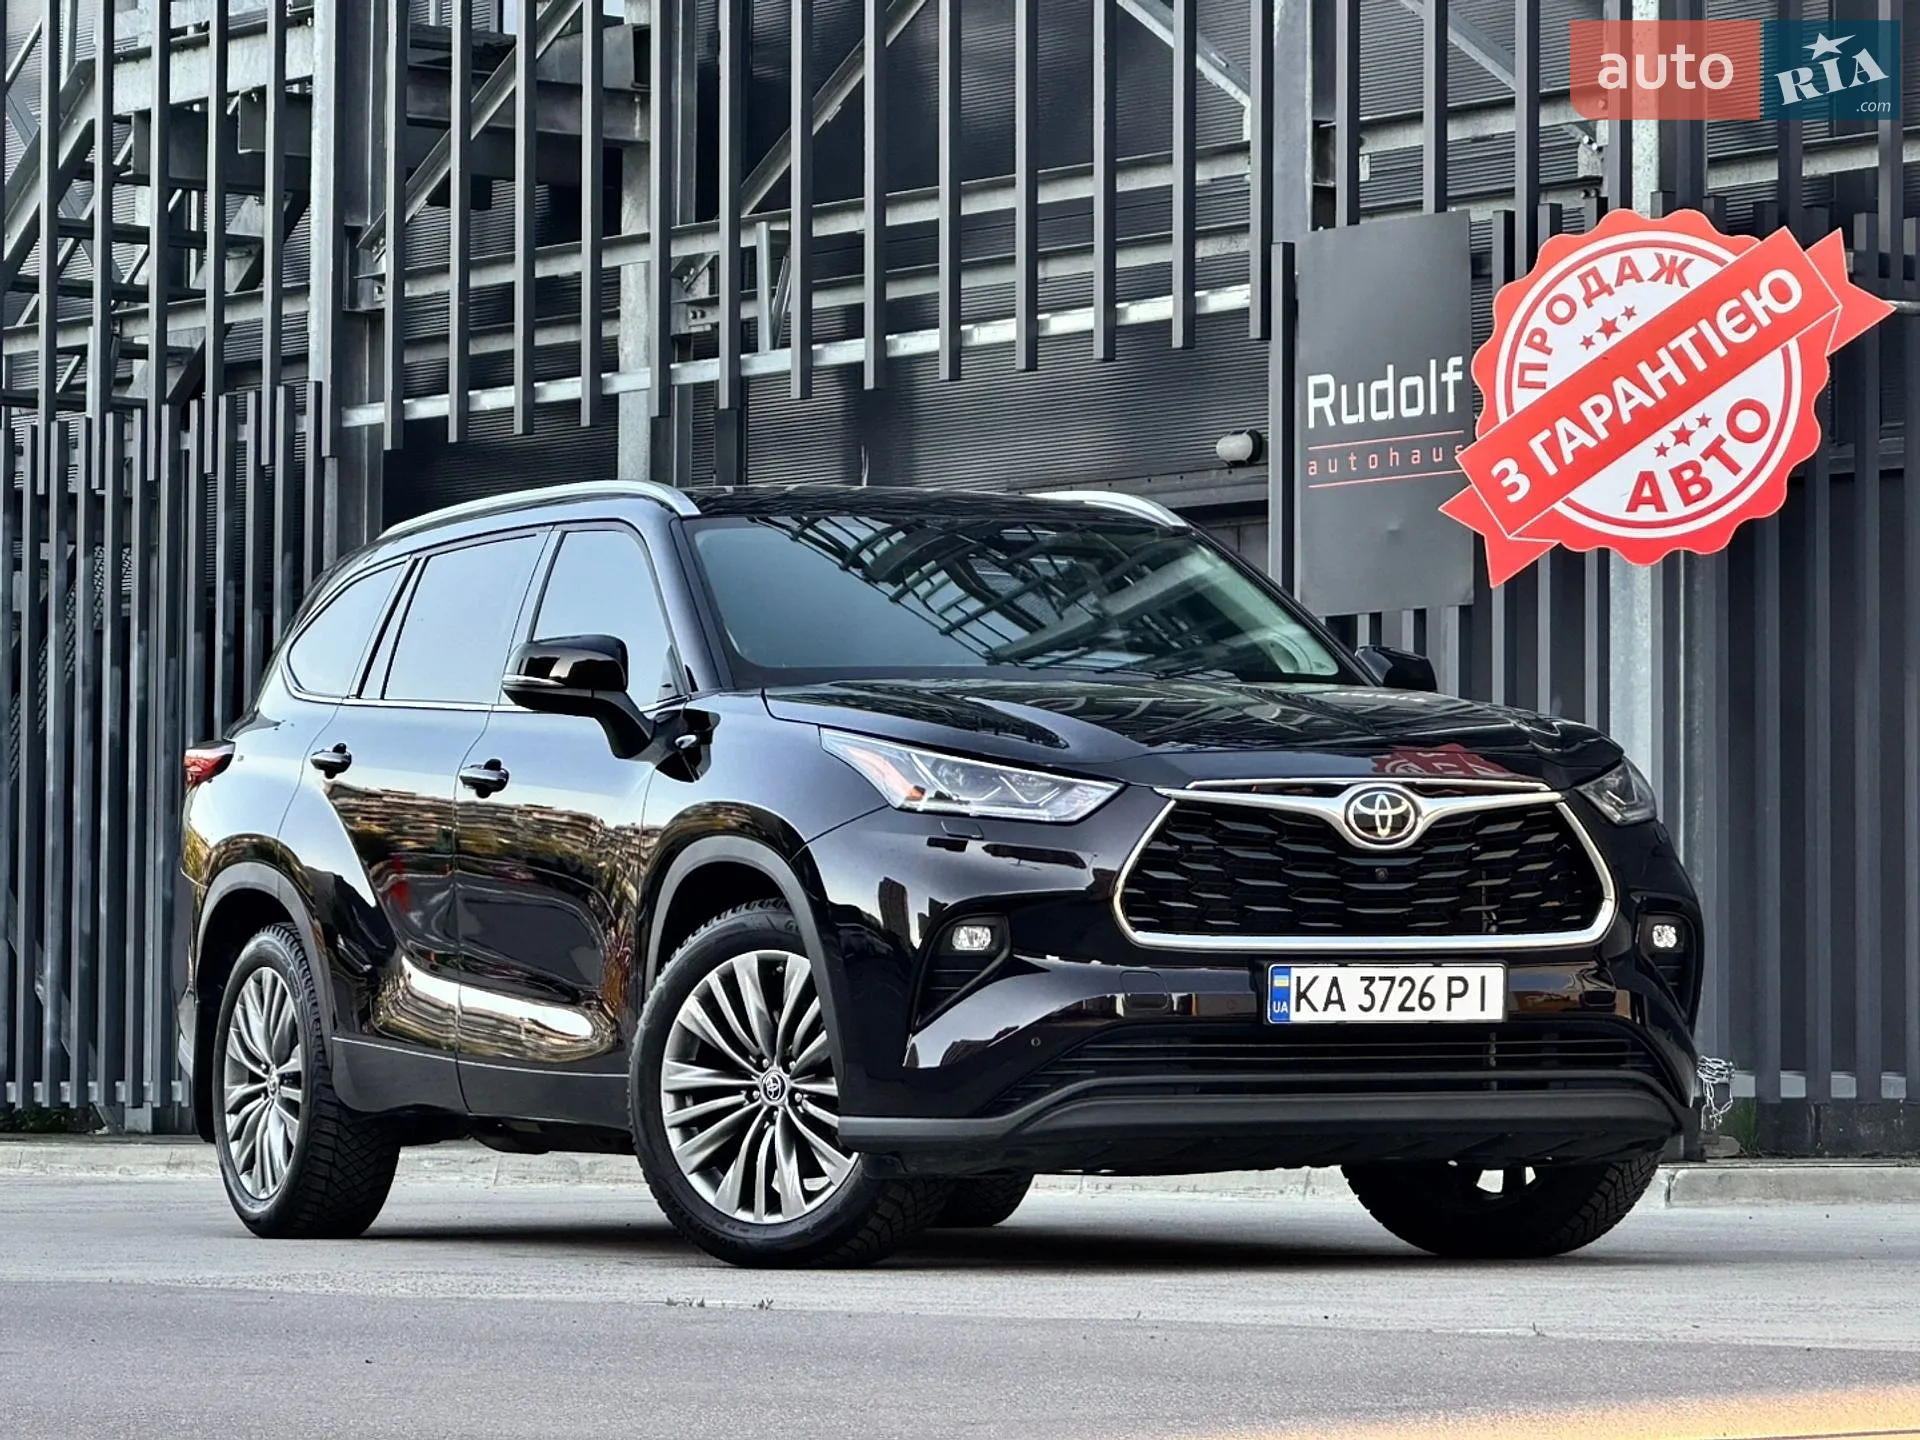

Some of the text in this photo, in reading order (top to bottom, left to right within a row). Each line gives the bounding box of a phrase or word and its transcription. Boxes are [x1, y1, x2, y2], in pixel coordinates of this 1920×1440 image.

[1517, 252, 1695, 390] ПРОДАЖ
[1307, 356, 1463, 429] Rudolf
[1528, 268, 1804, 477] ГАРАНТІЄЮ
[1625, 397, 1771, 513] АВТО
[1273, 1002, 1289, 1014] UA
[1295, 975, 1346, 1013] KA
[1358, 974, 1437, 1013] 3726
